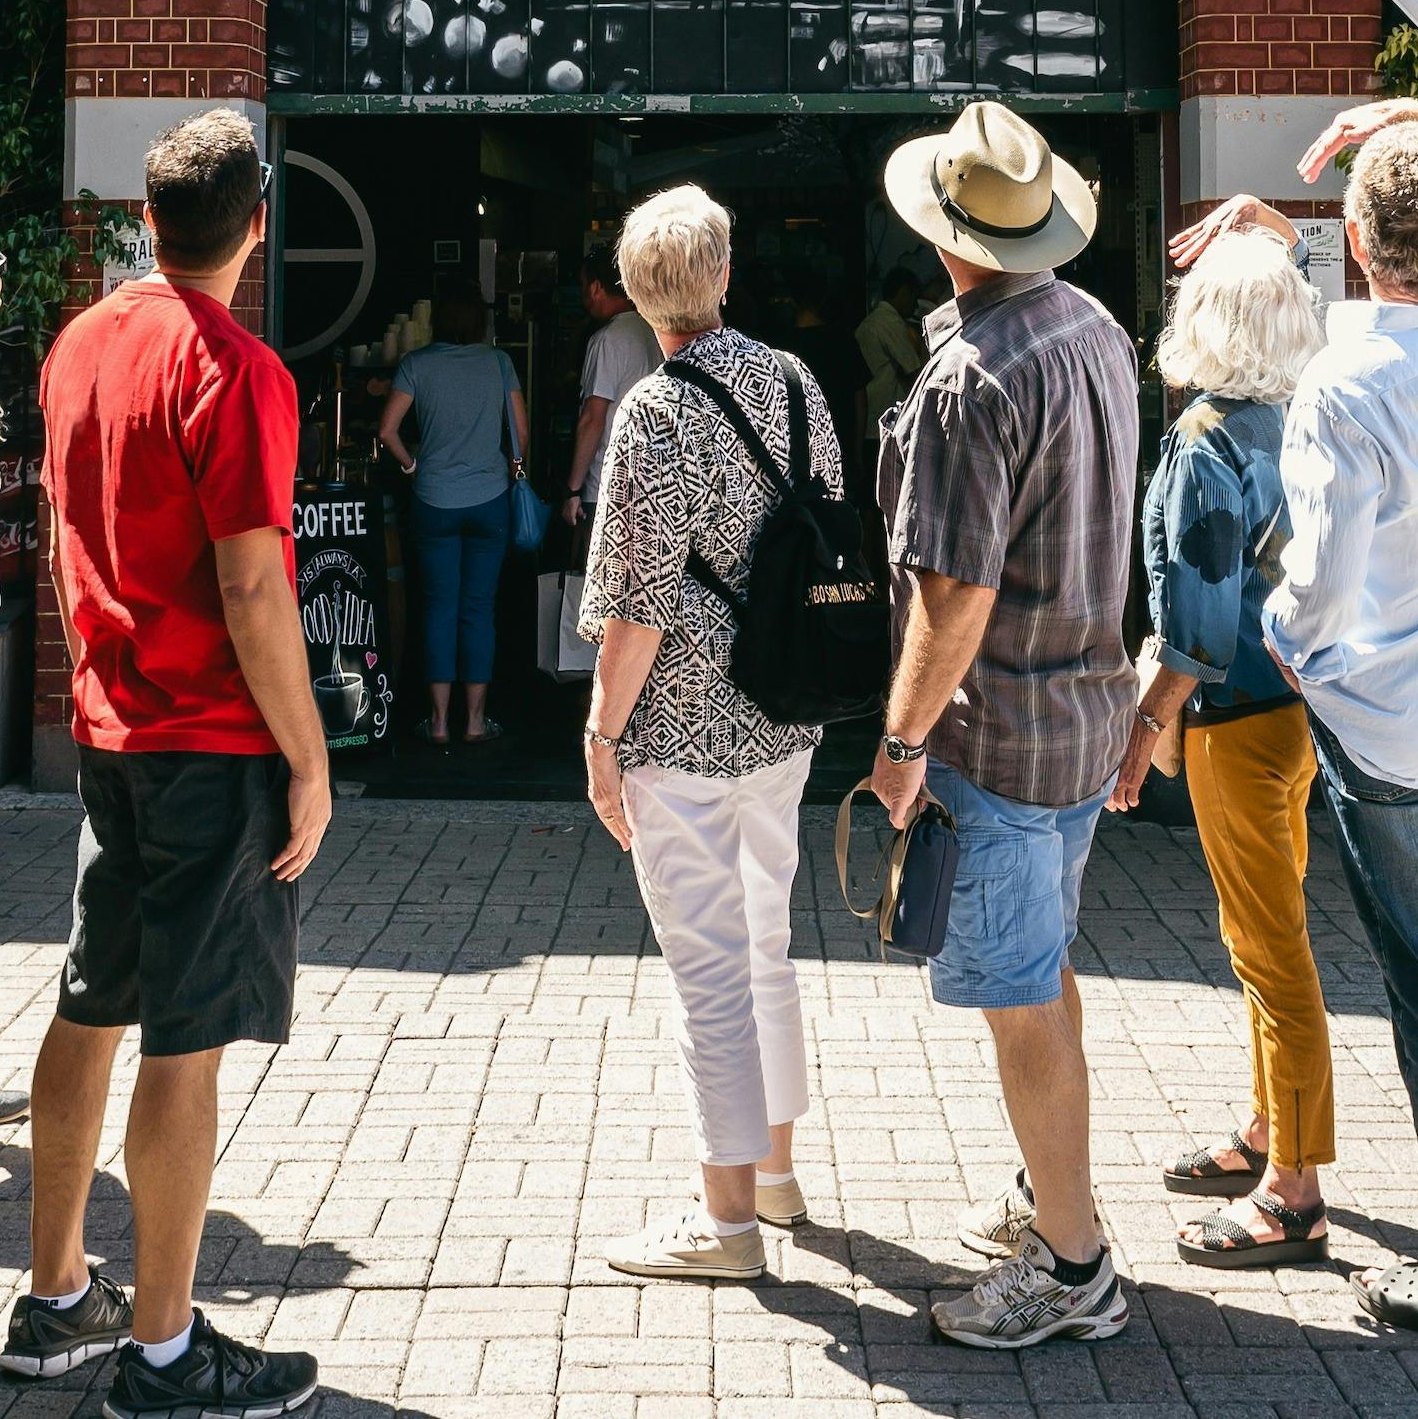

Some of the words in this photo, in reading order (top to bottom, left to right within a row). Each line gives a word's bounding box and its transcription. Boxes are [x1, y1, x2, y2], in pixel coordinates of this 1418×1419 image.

[292, 501, 368, 540] COFFEE
[303, 568, 314, 583] IS
[315, 552, 349, 571] ALWAYS
[352, 565, 360, 579] A
[303, 593, 334, 645] OOD
[341, 590, 377, 647] IDEA
